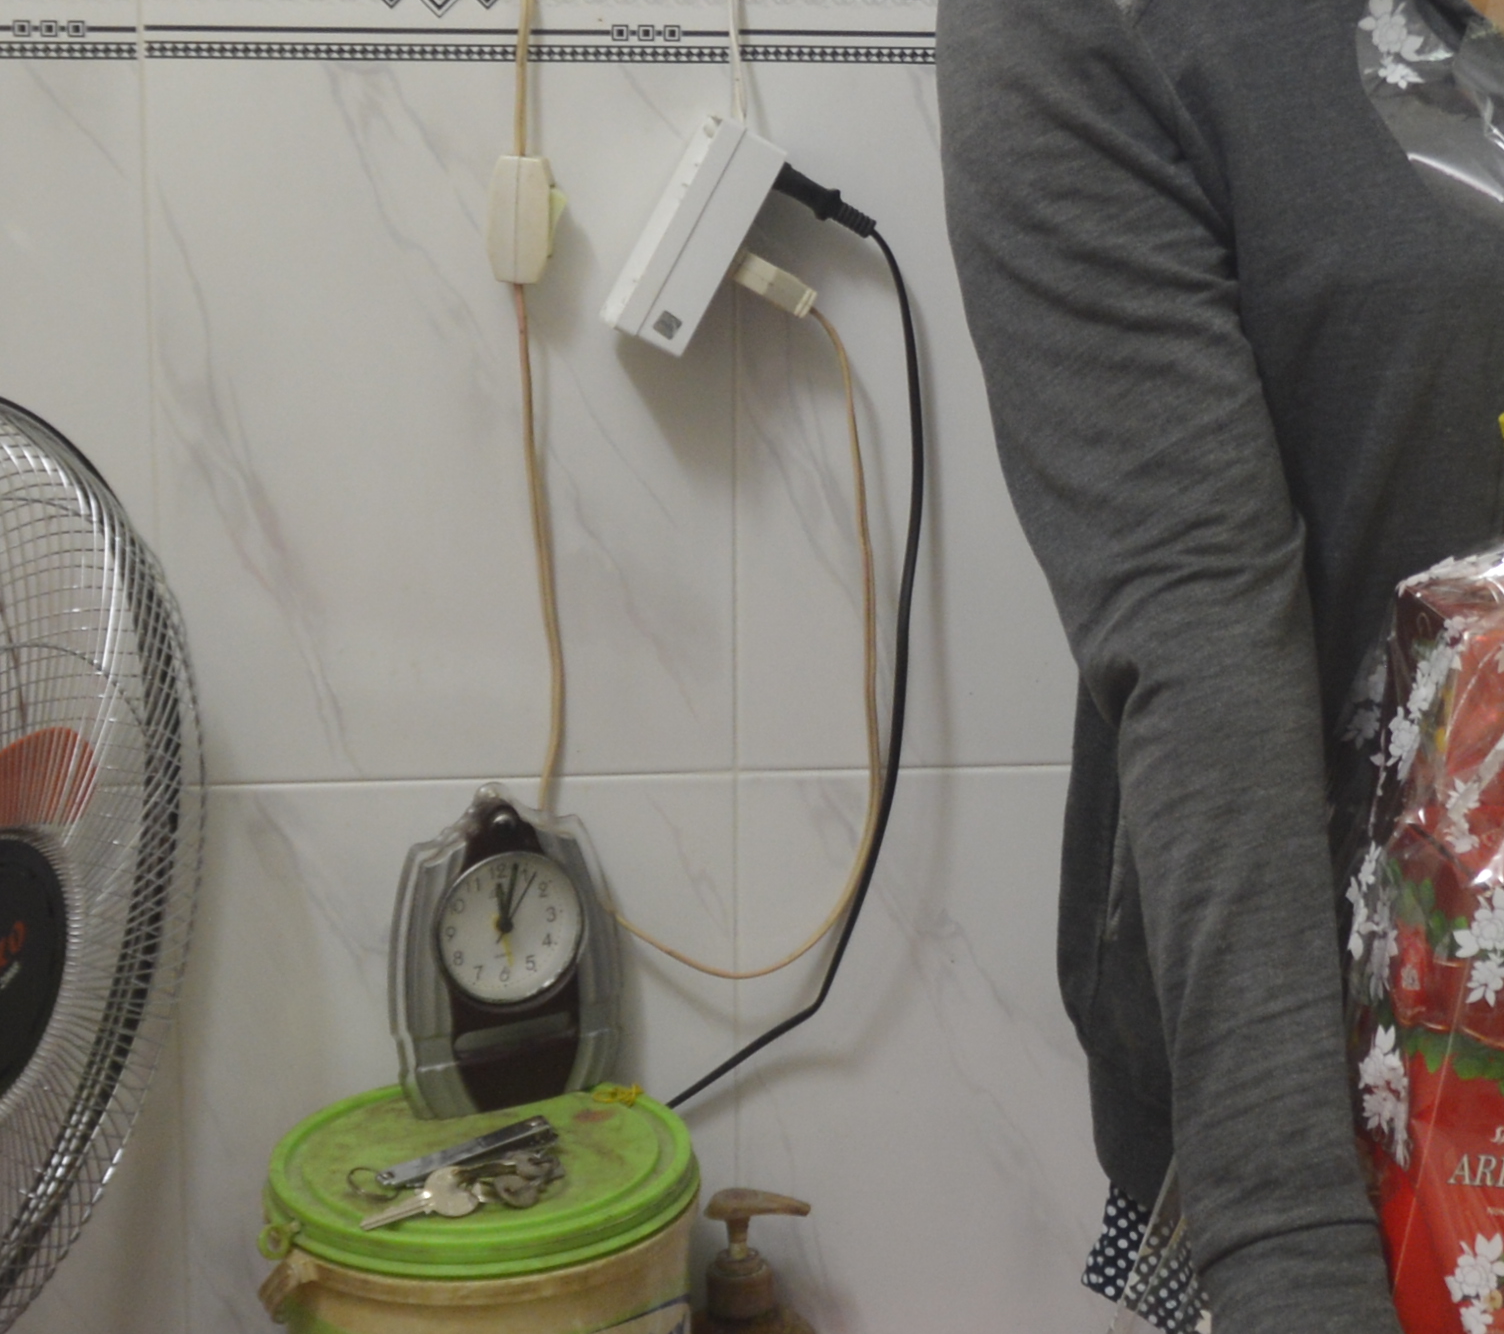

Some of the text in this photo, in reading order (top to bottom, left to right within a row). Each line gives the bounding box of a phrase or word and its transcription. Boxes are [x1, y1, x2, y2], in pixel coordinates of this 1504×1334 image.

[489, 863, 507, 879] 12
[466, 877, 481, 893] 11
[538, 881, 548, 898] 2
[546, 906, 557, 923] 3
[445, 926, 456, 942] 9
[542, 933, 552, 948] 4
[452, 950, 464, 966] 8
[525, 955, 536, 971] 5
[473, 964, 484, 981] 7
[499, 966, 510, 983] 6
